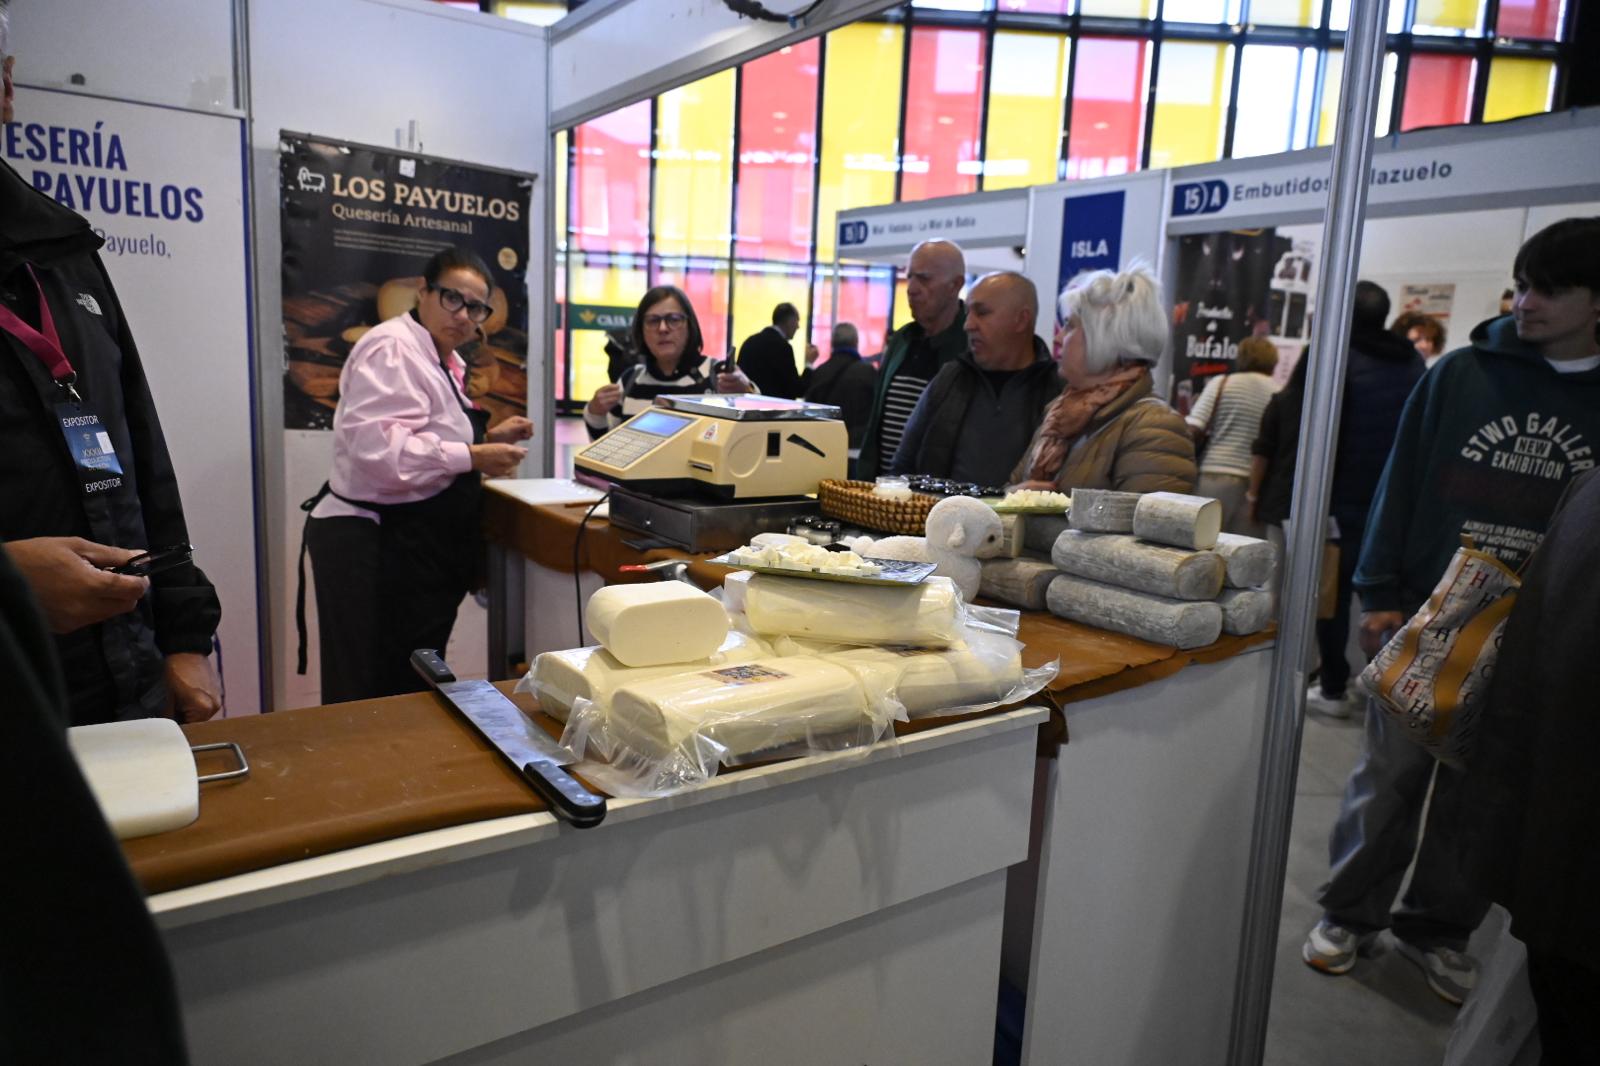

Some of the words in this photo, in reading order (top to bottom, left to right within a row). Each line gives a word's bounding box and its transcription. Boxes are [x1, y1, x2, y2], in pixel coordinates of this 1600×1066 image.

[0, 121, 128, 171] ESERÍA
[32, 170, 204, 223] PAYUELOS
[332, 174, 386, 202] LOS
[394, 183, 520, 222] PAYUELOS
[1233, 176, 1330, 202] Embutidos
[332, 203, 400, 226] Quesería
[403, 213, 473, 235] Artesanal
[1071, 239, 1108, 259] ISLA
[63, 415, 99, 428] EXPOSITOR
[1461, 415, 1519, 462] STWD
[1515, 436, 1552, 458] NEW
[1491, 450, 1566, 481] EXHIBITION
[85, 478, 122, 493] EXPOSITOR
